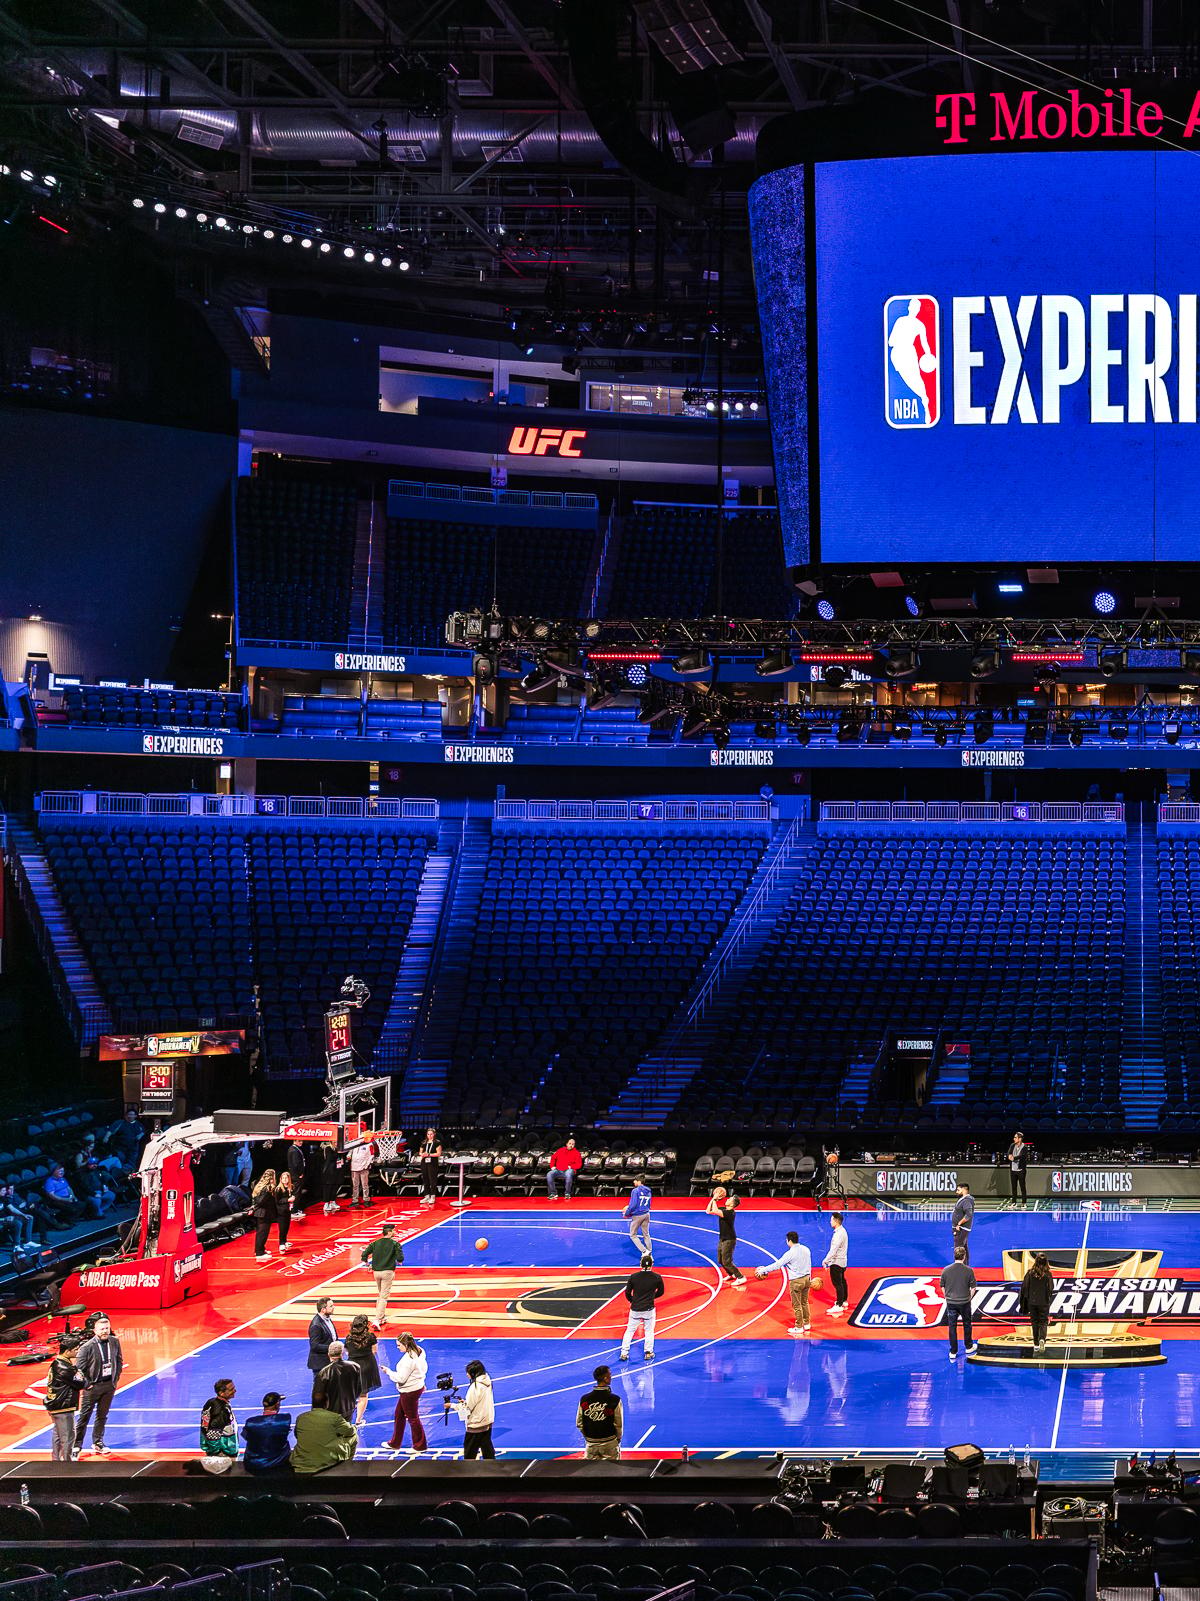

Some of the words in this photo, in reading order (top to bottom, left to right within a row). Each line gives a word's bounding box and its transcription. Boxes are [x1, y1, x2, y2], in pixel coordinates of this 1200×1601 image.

[989, 88, 1163, 141] Mobile
[893, 397, 919, 419] NBA
[508, 427, 587, 458] UFC
[344, 654, 406, 673] EXPERIENCES
[153, 736, 224, 755] EXPERIENCES
[454, 745, 514, 763] EXPERIENCES
[718, 749, 774, 766] EXPERIENCES
[969, 750, 1025, 767] EXPERIENCES
[262, 801, 274, 812] 18
[640, 805, 652, 817] 17
[1016, 807, 1026, 818] 16
[332, 1029, 347, 1050] 24
[902, 1040, 933, 1050] EXPERIENCES
[149, 1076, 166, 1088] 24
[886, 1171, 957, 1192] EXPERIENCES
[1062, 1171, 1133, 1192] EXPERIENCES
[639, 1196, 650, 1207] 77
[87, 1272, 105, 1287] NBA
[105, 1272, 137, 1290] League
[137, 1272, 160, 1287] Pass
[1053, 1278, 1178, 1292] -SEASON
[868, 1314, 909, 1324] NBA
[584, 1402, 607, 1417] Just
